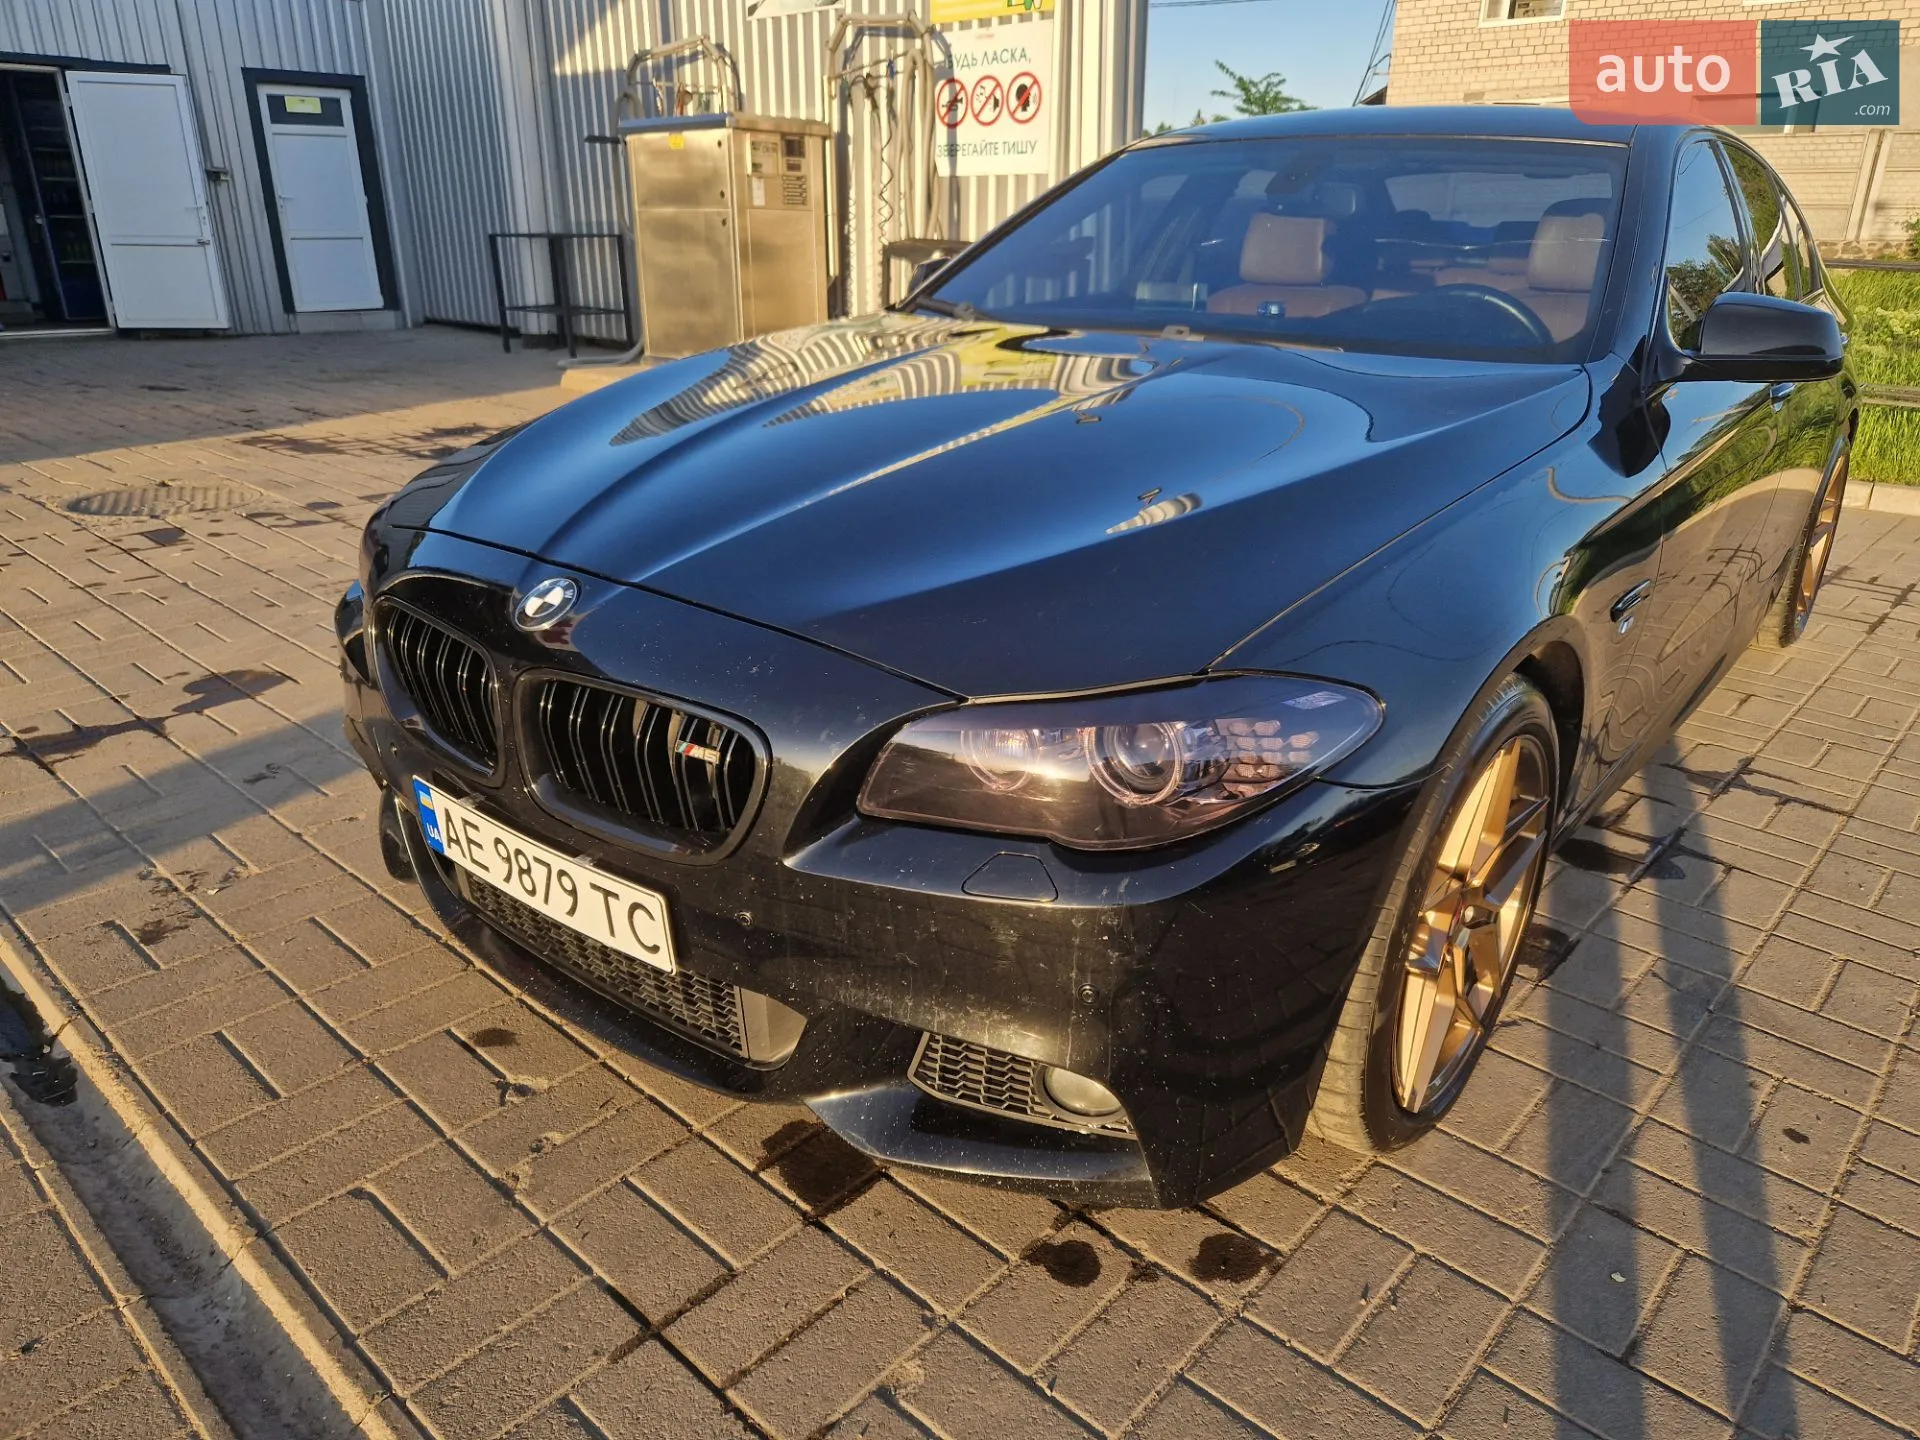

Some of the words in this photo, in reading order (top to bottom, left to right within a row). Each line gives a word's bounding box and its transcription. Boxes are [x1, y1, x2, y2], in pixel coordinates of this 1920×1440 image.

[981, 47, 1032, 66] ЛАСКА,
[1002, 140, 1038, 155] ТИШУ
[426, 822, 442, 843] UA
[444, 807, 490, 873] AE
[493, 836, 579, 918] 9879
[590, 882, 661, 955] TC
